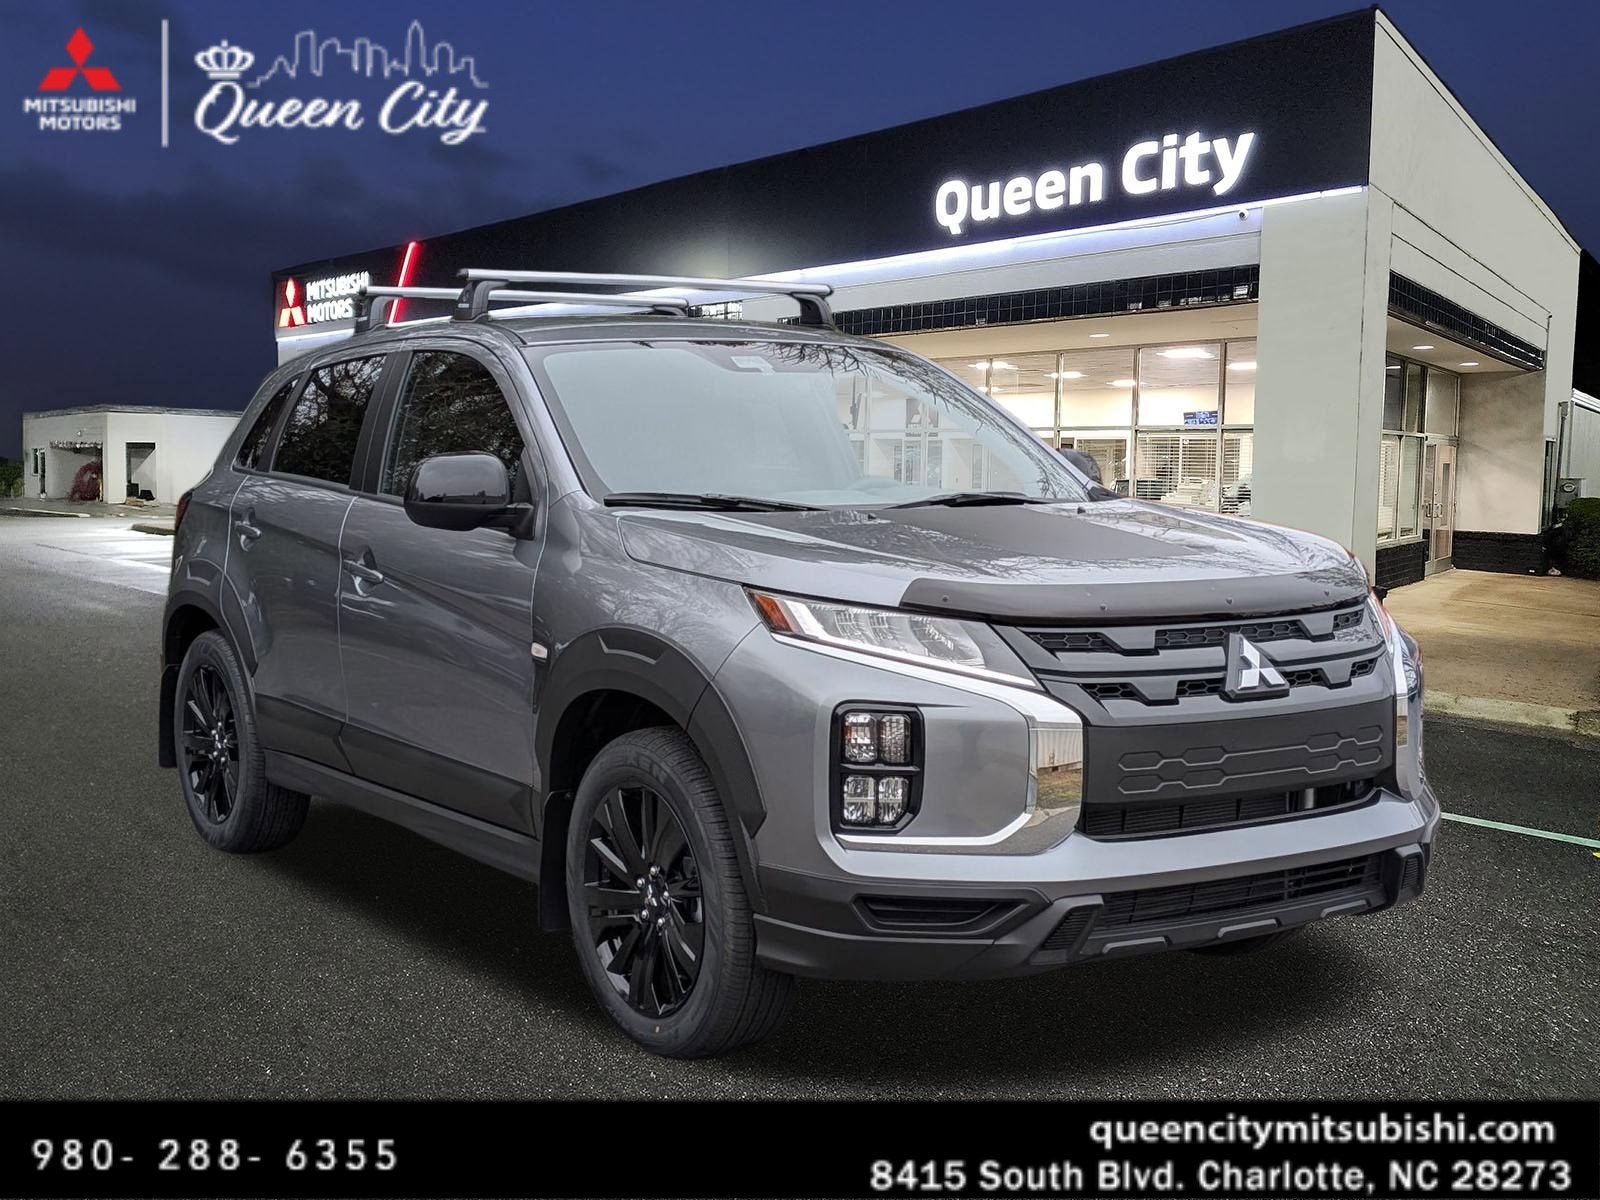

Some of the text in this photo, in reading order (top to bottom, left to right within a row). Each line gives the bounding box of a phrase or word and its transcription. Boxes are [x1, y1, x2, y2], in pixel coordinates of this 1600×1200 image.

[935, 131, 1256, 235] Queen City
[305, 270, 370, 302] MITSUBISHI
[306, 297, 356, 323] MOTORS
